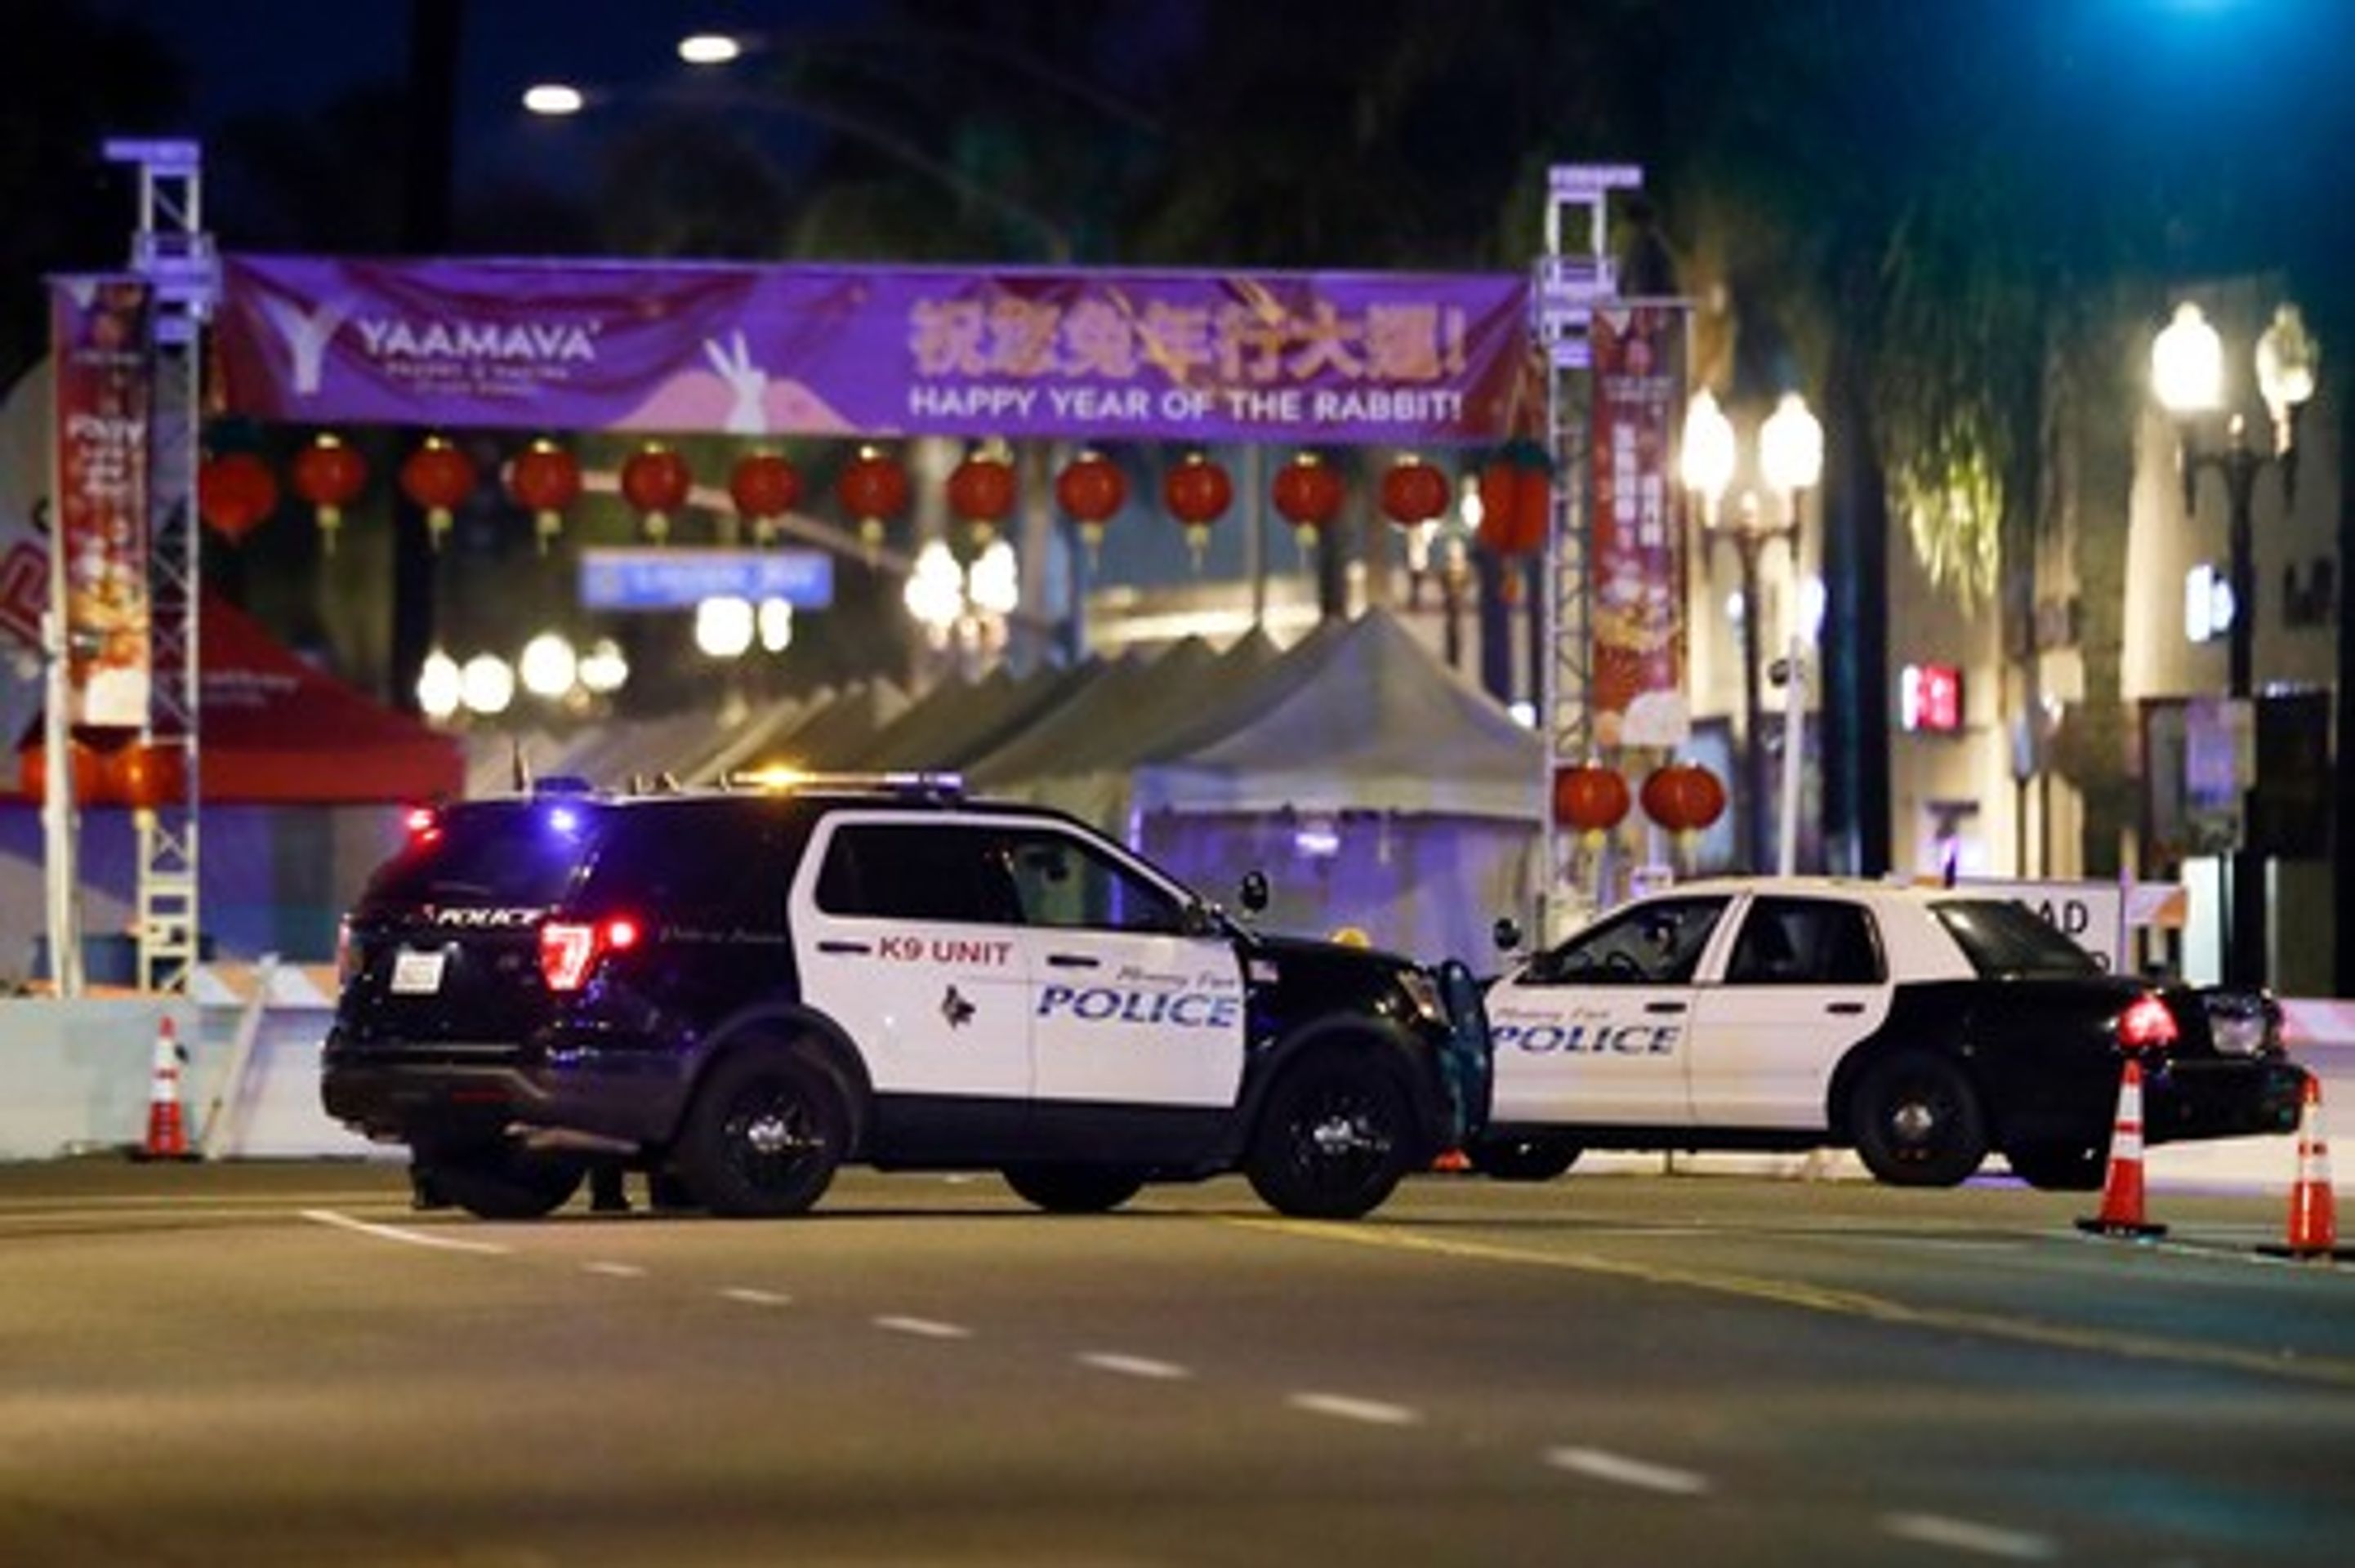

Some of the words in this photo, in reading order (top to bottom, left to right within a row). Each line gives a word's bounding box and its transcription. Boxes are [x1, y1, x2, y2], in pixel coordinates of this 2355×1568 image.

[910, 387, 1037, 419] HAPPY
[1050, 390, 1151, 420] YEAR
[1162, 390, 1216, 421] OF
[1230, 390, 1300, 421] THE
[1314, 390, 1462, 422] RABBIT!
[2038, 899, 2089, 933] AD
[879, 936, 921, 958] K9
[932, 937, 1013, 966] UNIT
[1037, 986, 1240, 1027] POLICE
[1491, 1023, 1681, 1054] POLICE
